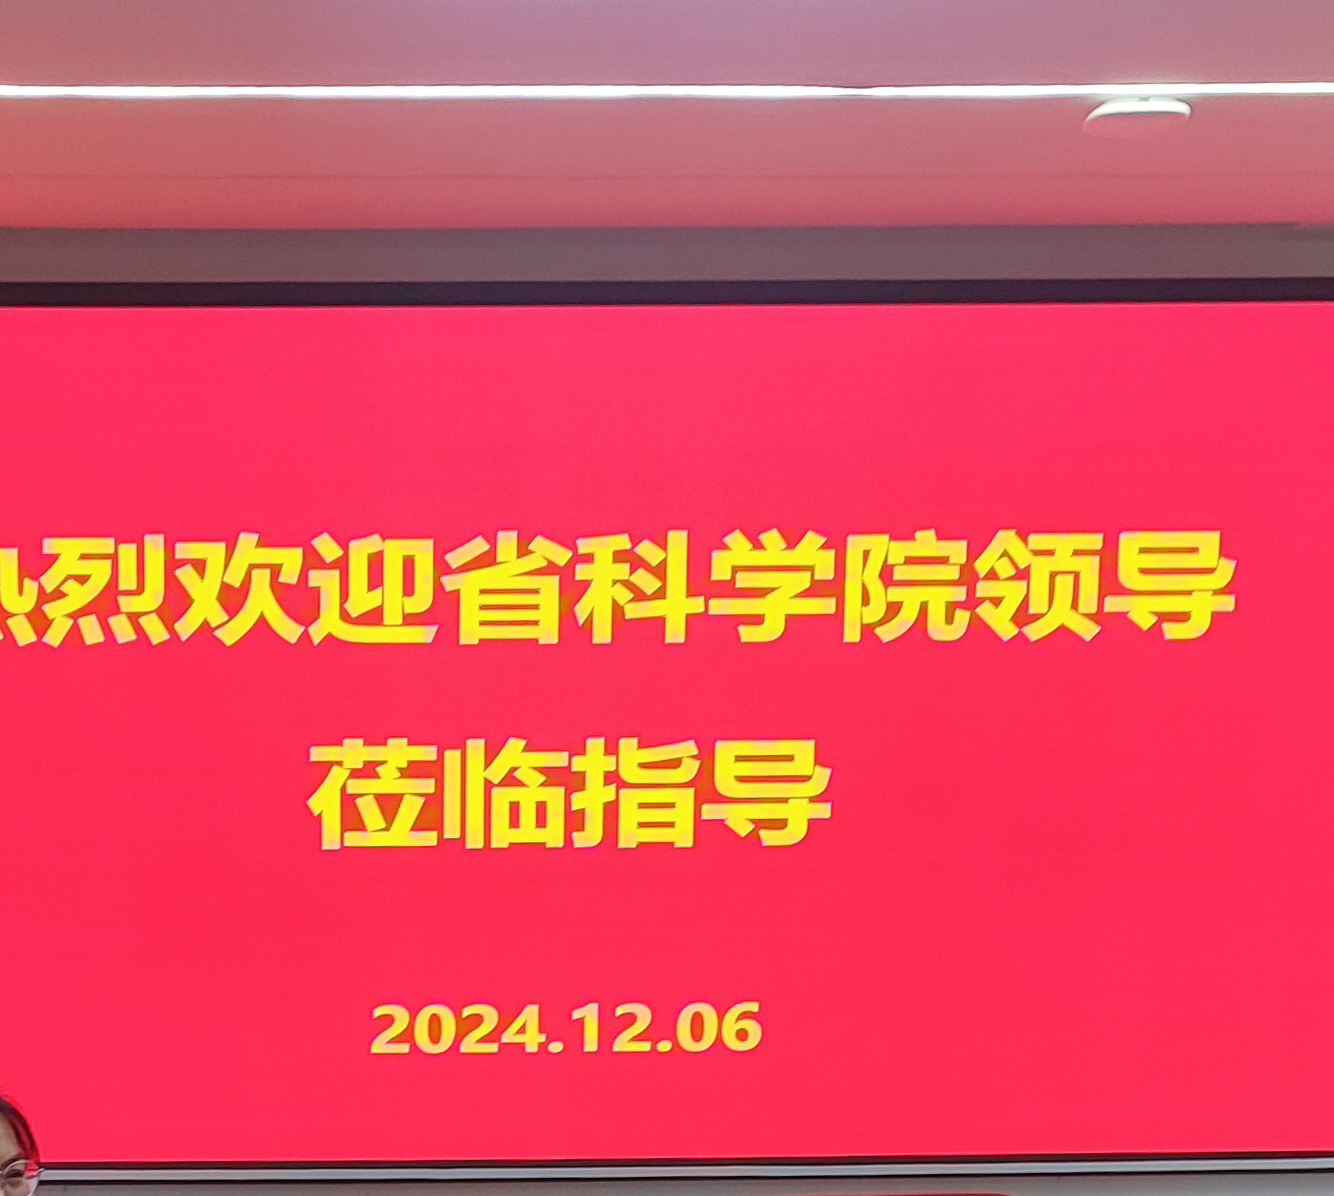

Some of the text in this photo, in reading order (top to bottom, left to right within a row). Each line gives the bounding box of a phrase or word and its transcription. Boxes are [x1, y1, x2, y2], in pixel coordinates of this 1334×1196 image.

[306, 736, 833, 850] 莅临指导
[369, 1000, 763, 1055] 2024.12.06
